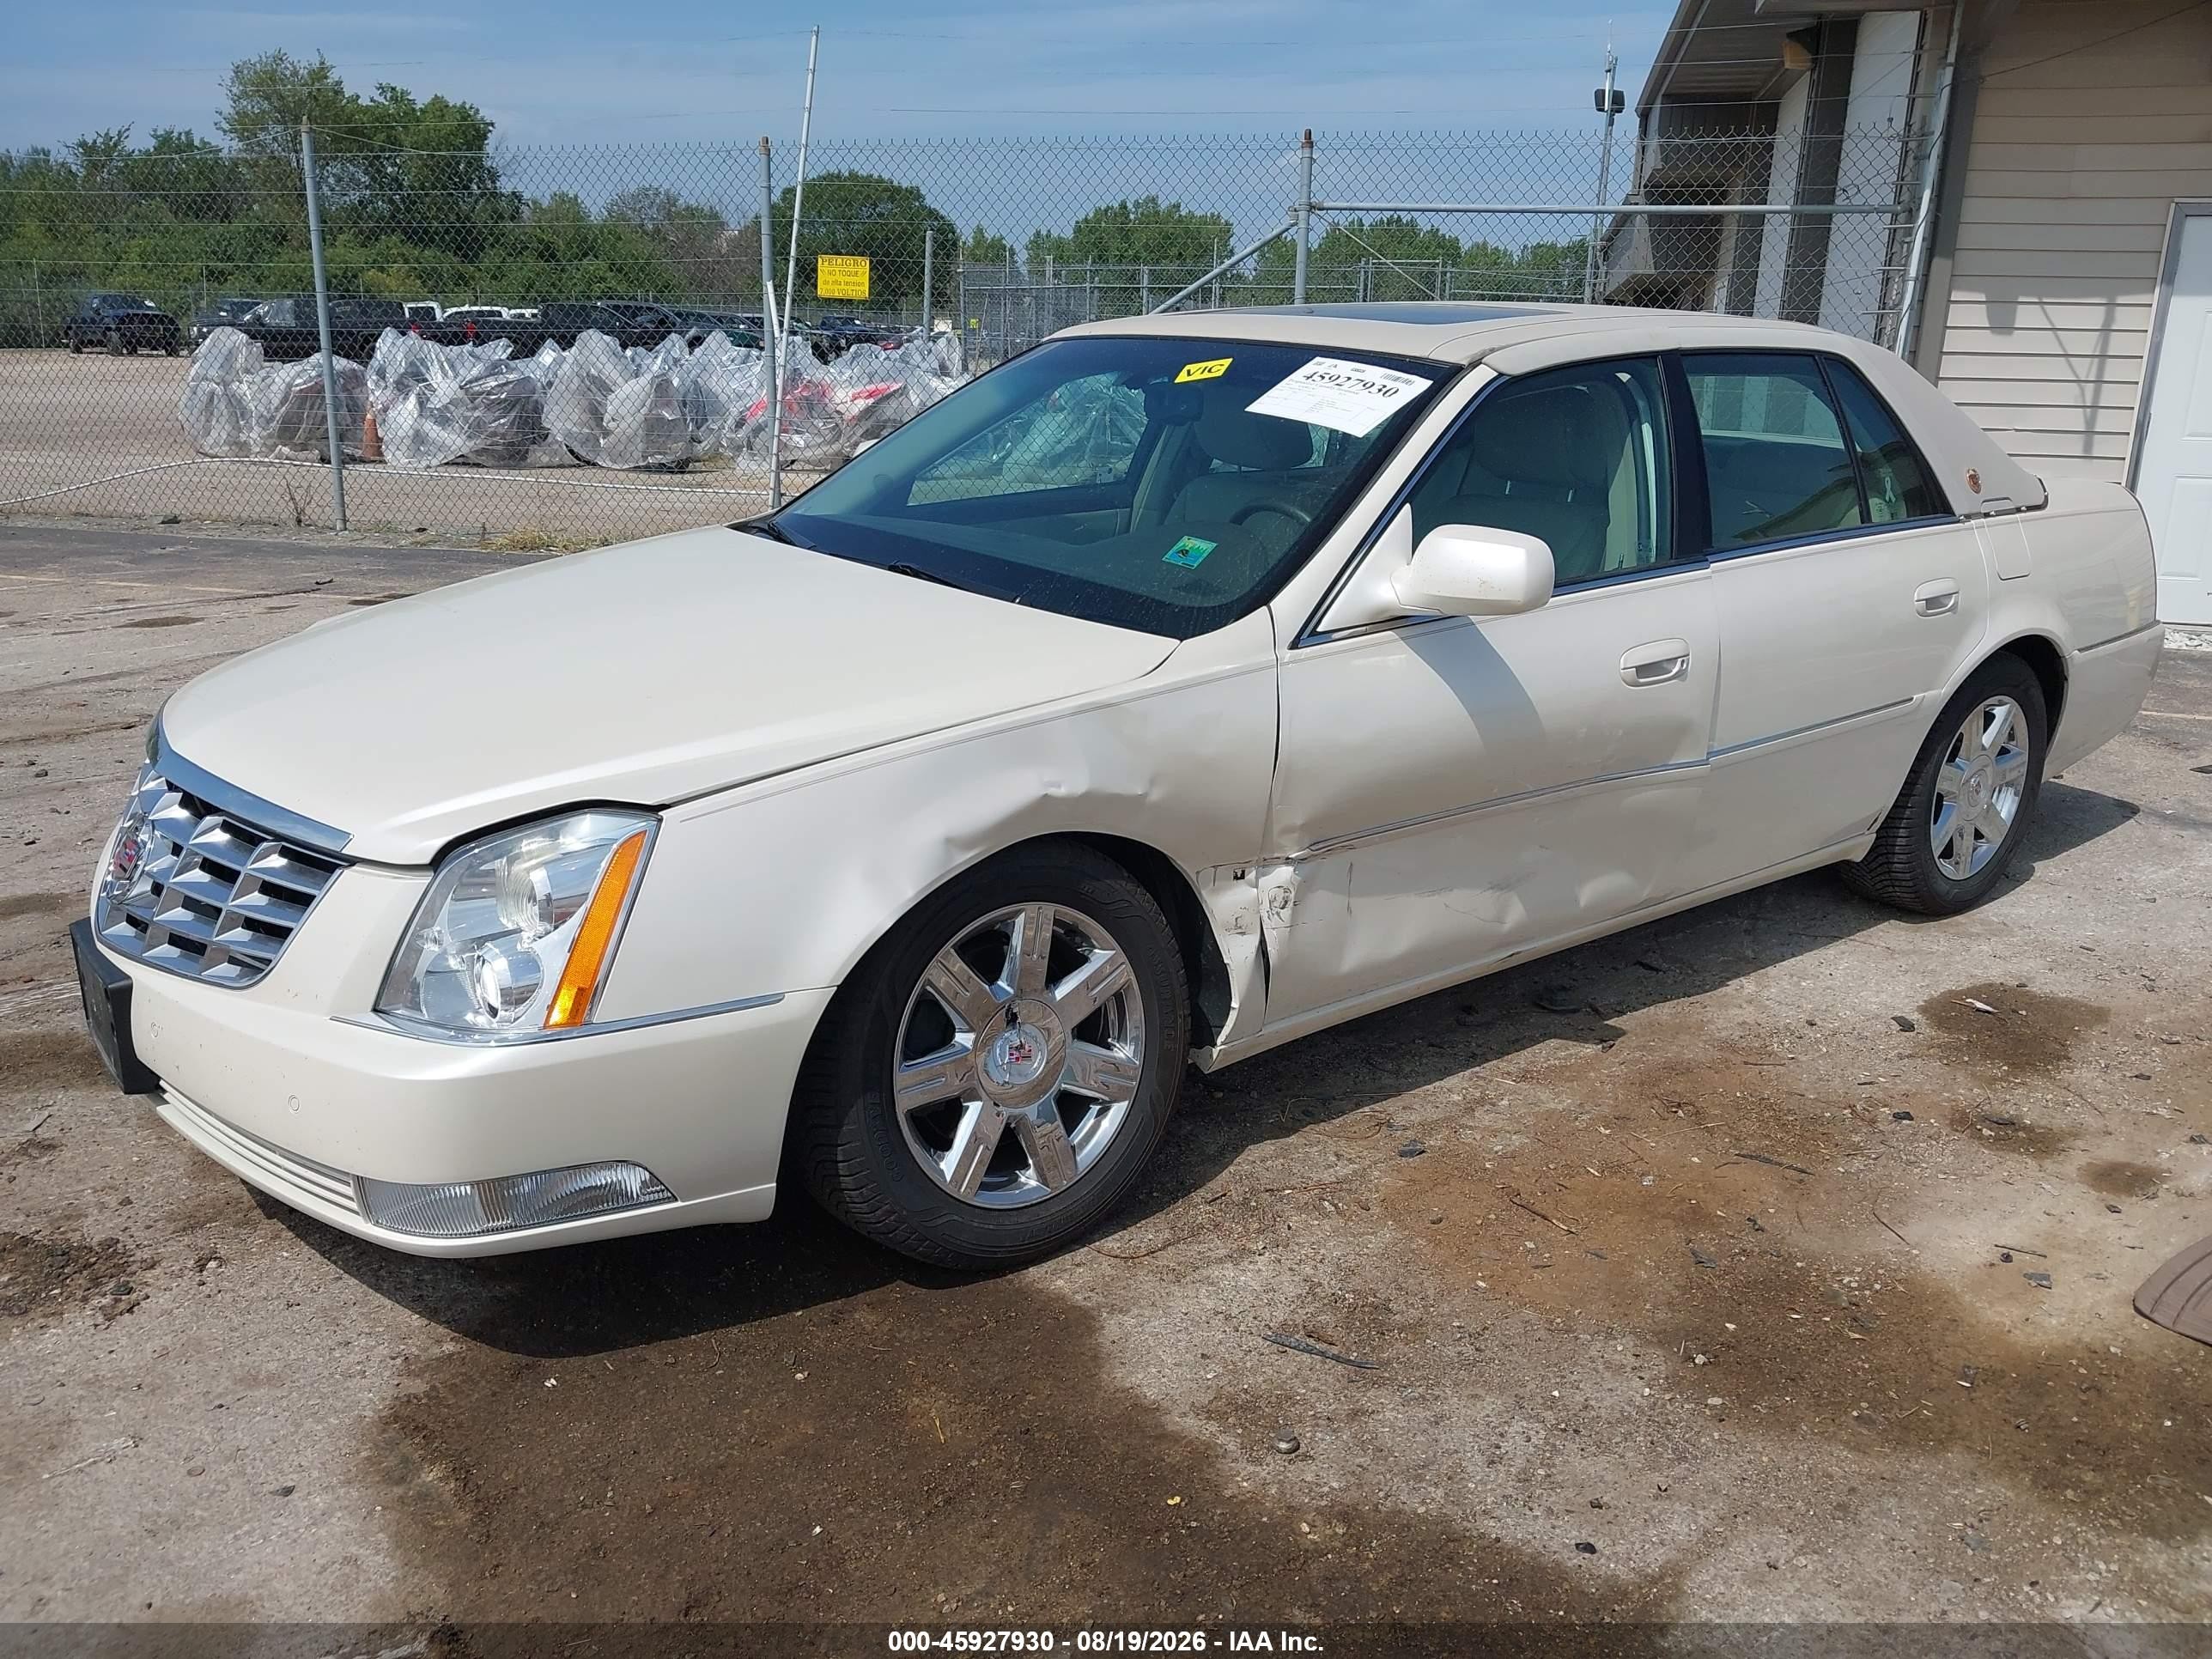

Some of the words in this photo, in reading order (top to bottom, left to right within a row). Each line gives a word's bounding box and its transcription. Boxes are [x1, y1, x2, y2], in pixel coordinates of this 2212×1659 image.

[821, 258, 867, 268] PELIGRO
[838, 269, 860, 277] TOQUE
[1186, 364, 1225, 377] VIC
[1303, 370, 1400, 398] 45927930
